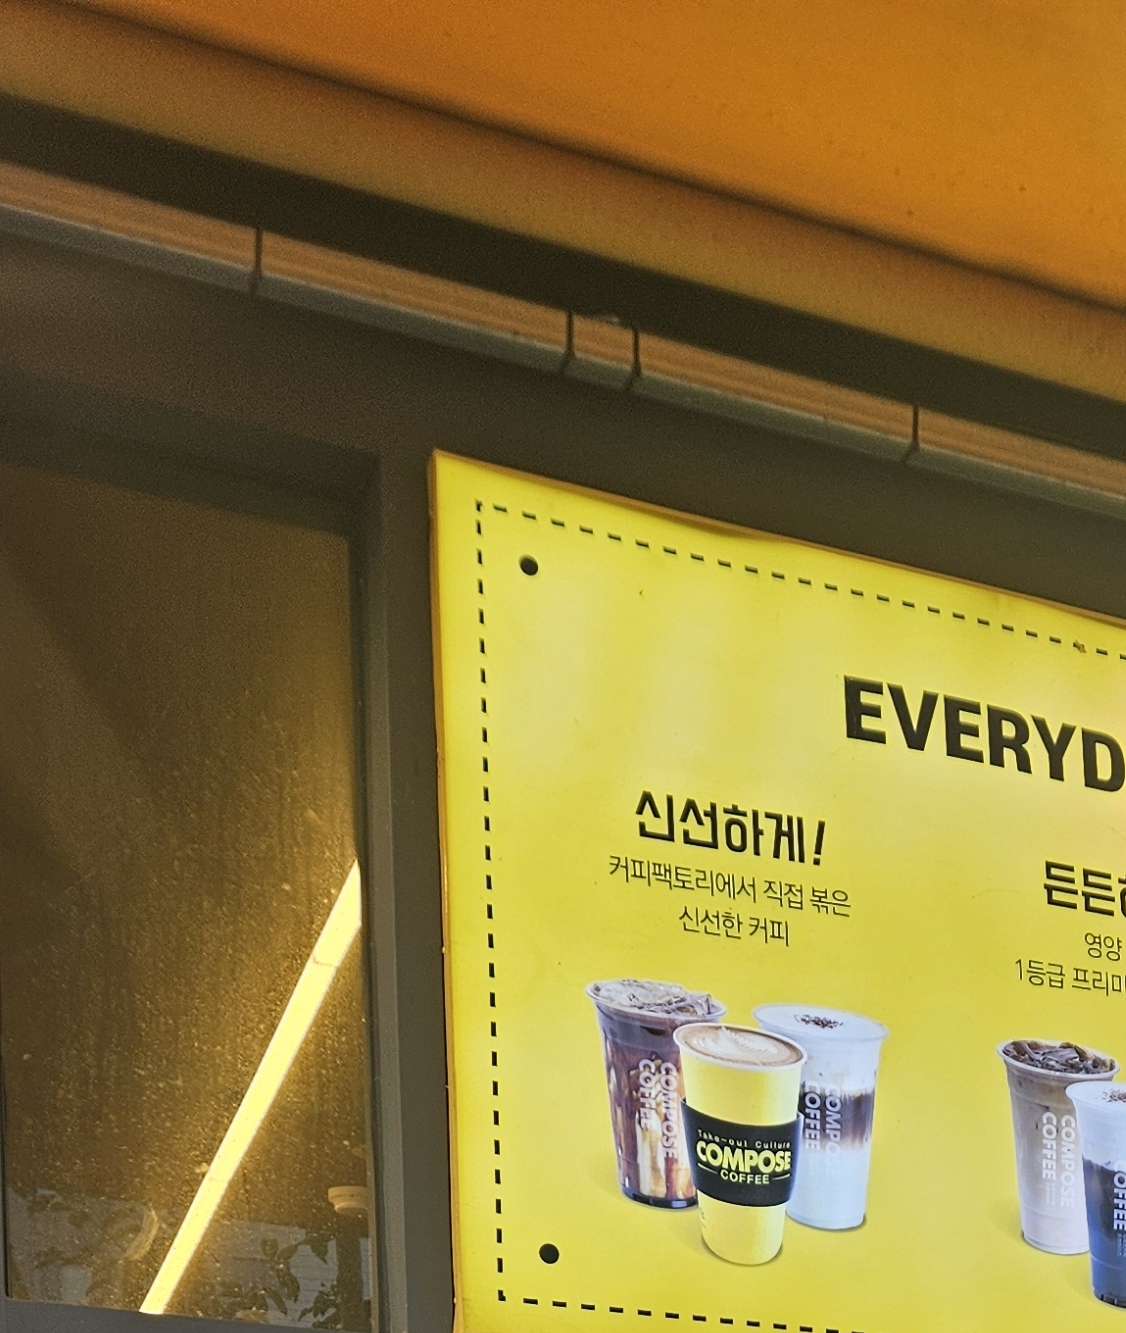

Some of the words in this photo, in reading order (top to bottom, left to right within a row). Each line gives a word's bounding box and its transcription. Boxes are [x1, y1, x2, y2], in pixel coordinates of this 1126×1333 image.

[635, 790, 826, 866] 신선하게!
[608, 854, 757, 903] 커피팩토리에서
[762, 878, 804, 910] 직접
[809, 885, 851, 917] 볶은
[679, 905, 743, 940] 신선한
[748, 917, 790, 947] 커피
[1083, 931, 1123, 962] 영양
[1014, 957, 1066, 989] 1등급
[638, 1058, 656, 1129] COFFEE
[660, 1062, 678, 1160] COMPOSE
[696, 1140, 792, 1174] COMPOSE
[697, 1128, 748, 1148] Take-out
[1042, 1111, 1057, 1180] COFFEE
[1060, 1114, 1076, 1208] COMPOSE
[720, 1169, 770, 1185] COFFEE
